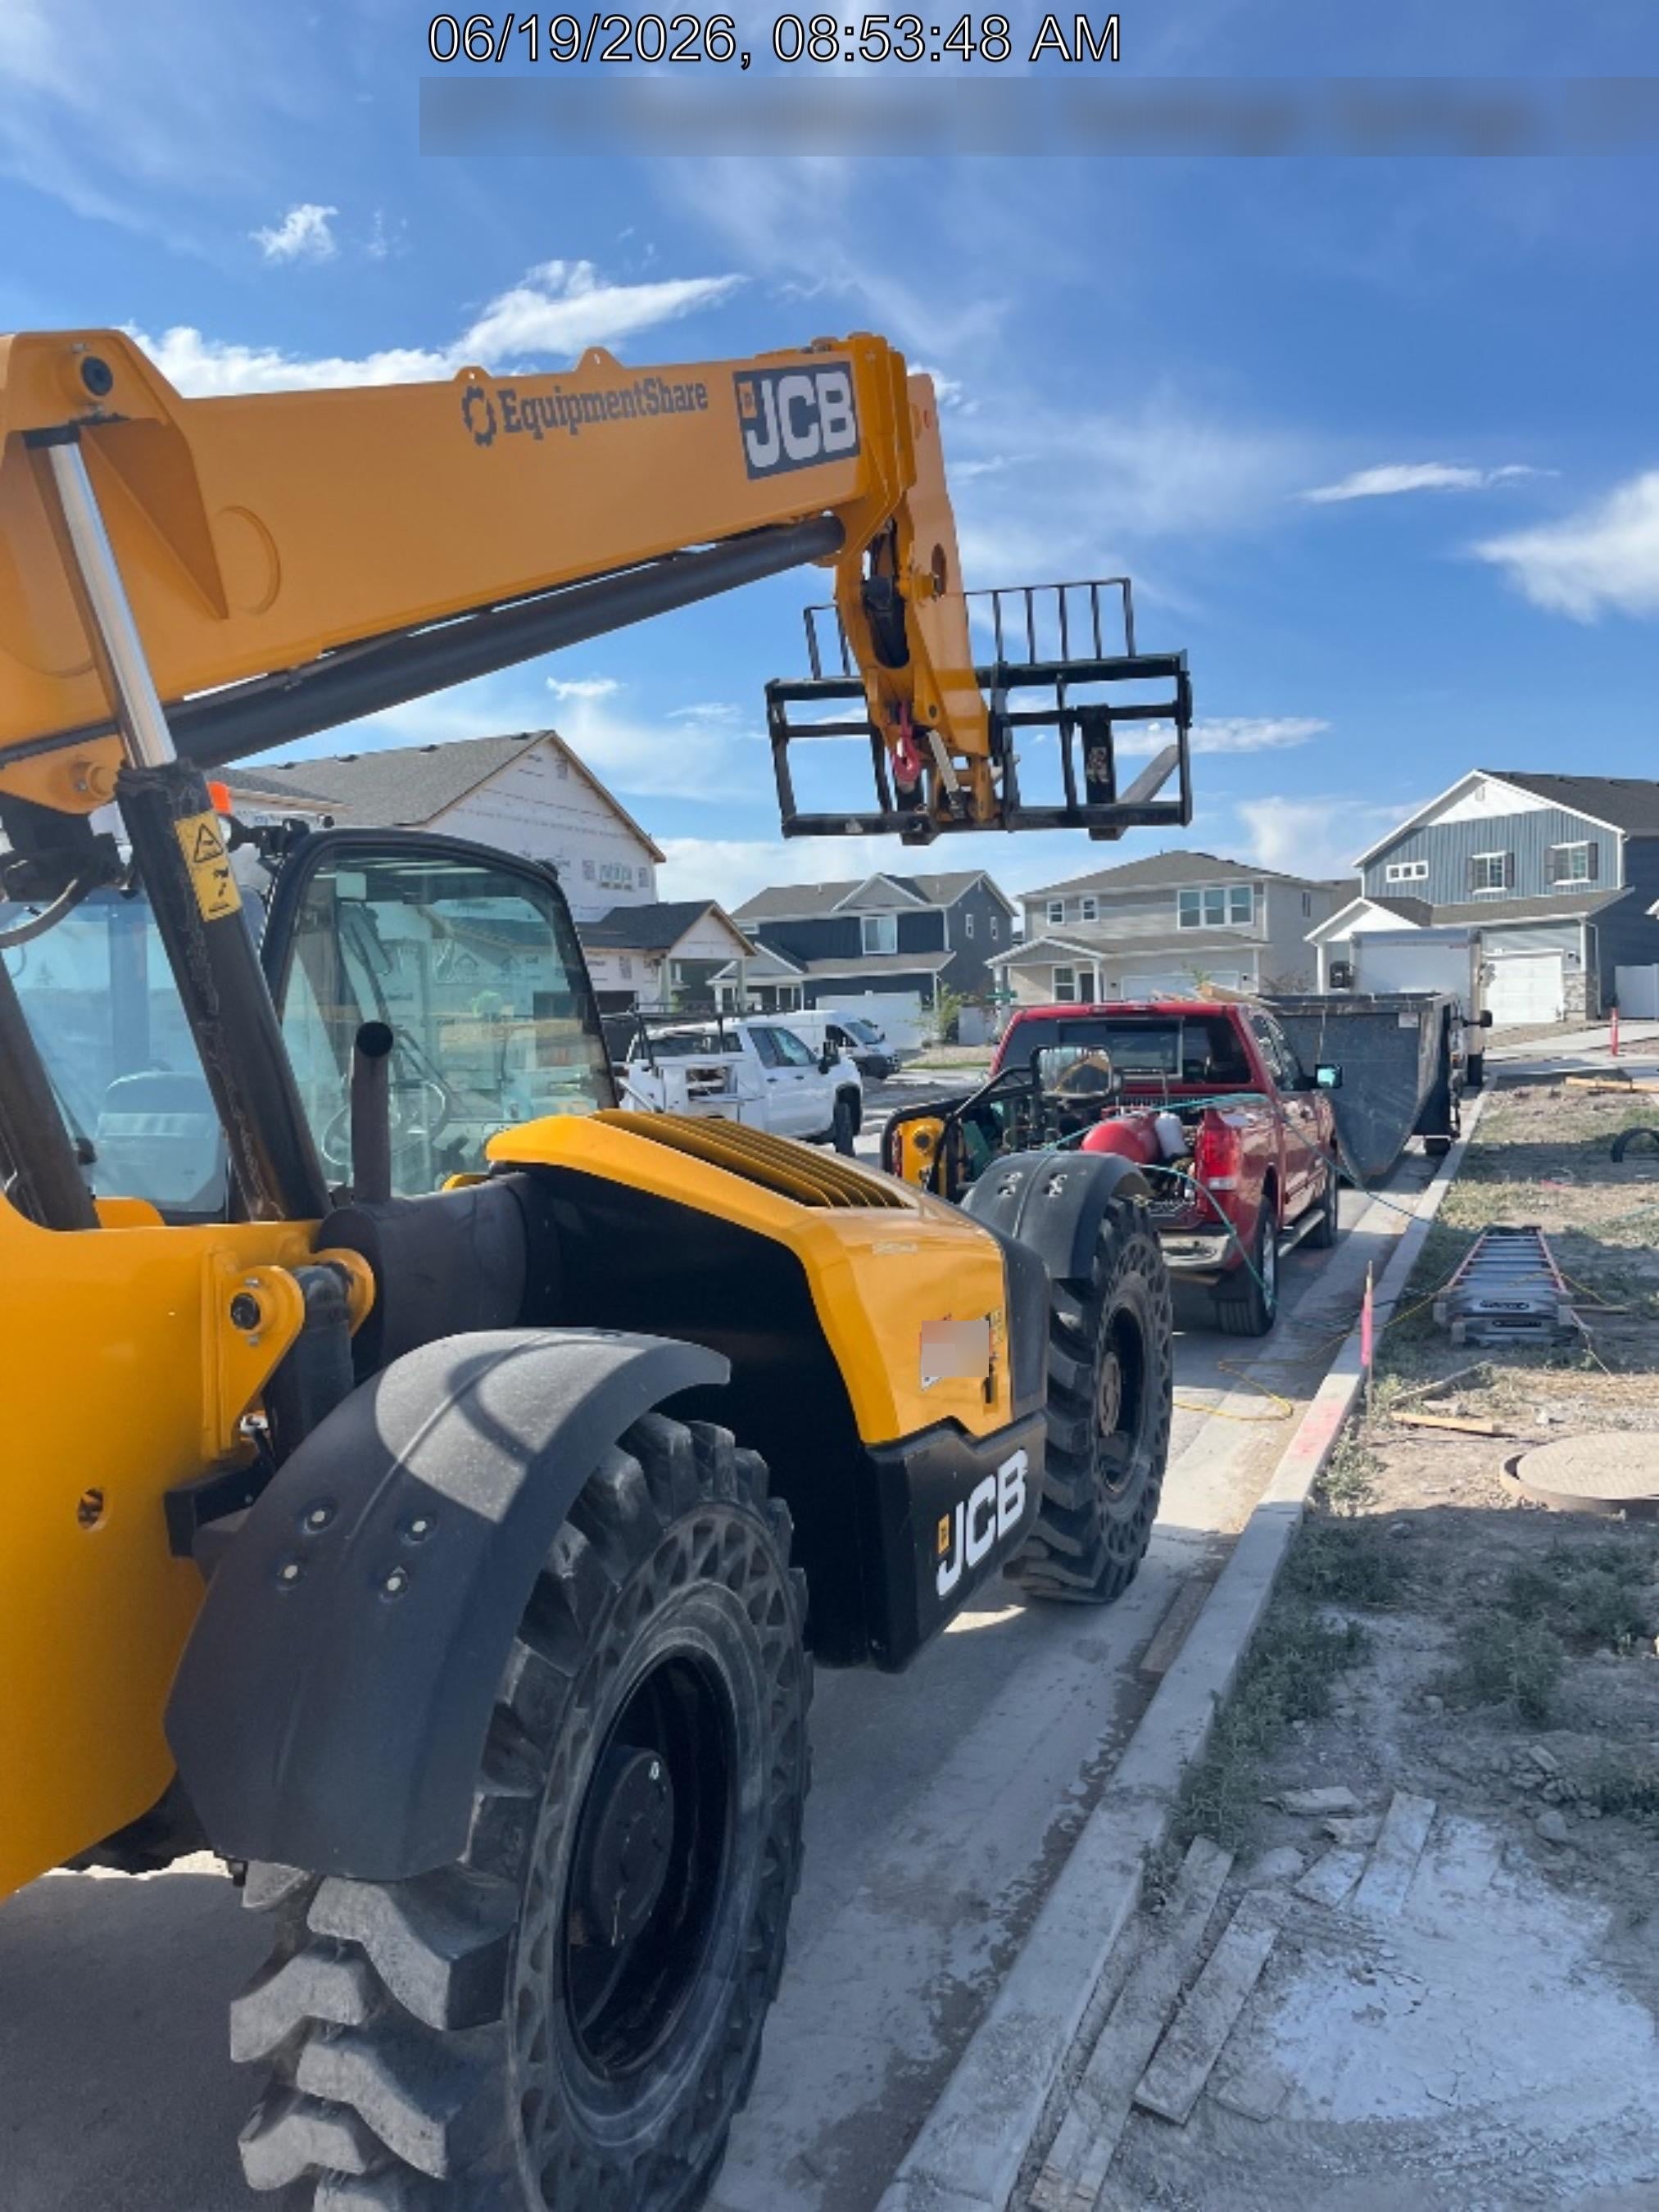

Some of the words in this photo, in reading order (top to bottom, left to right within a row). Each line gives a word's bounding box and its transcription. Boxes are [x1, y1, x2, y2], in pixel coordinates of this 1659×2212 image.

[497, 377, 709, 441] EquipmentShare
[744, 370, 857, 468] JCB
[936, 1448, 1029, 1598] JCB
